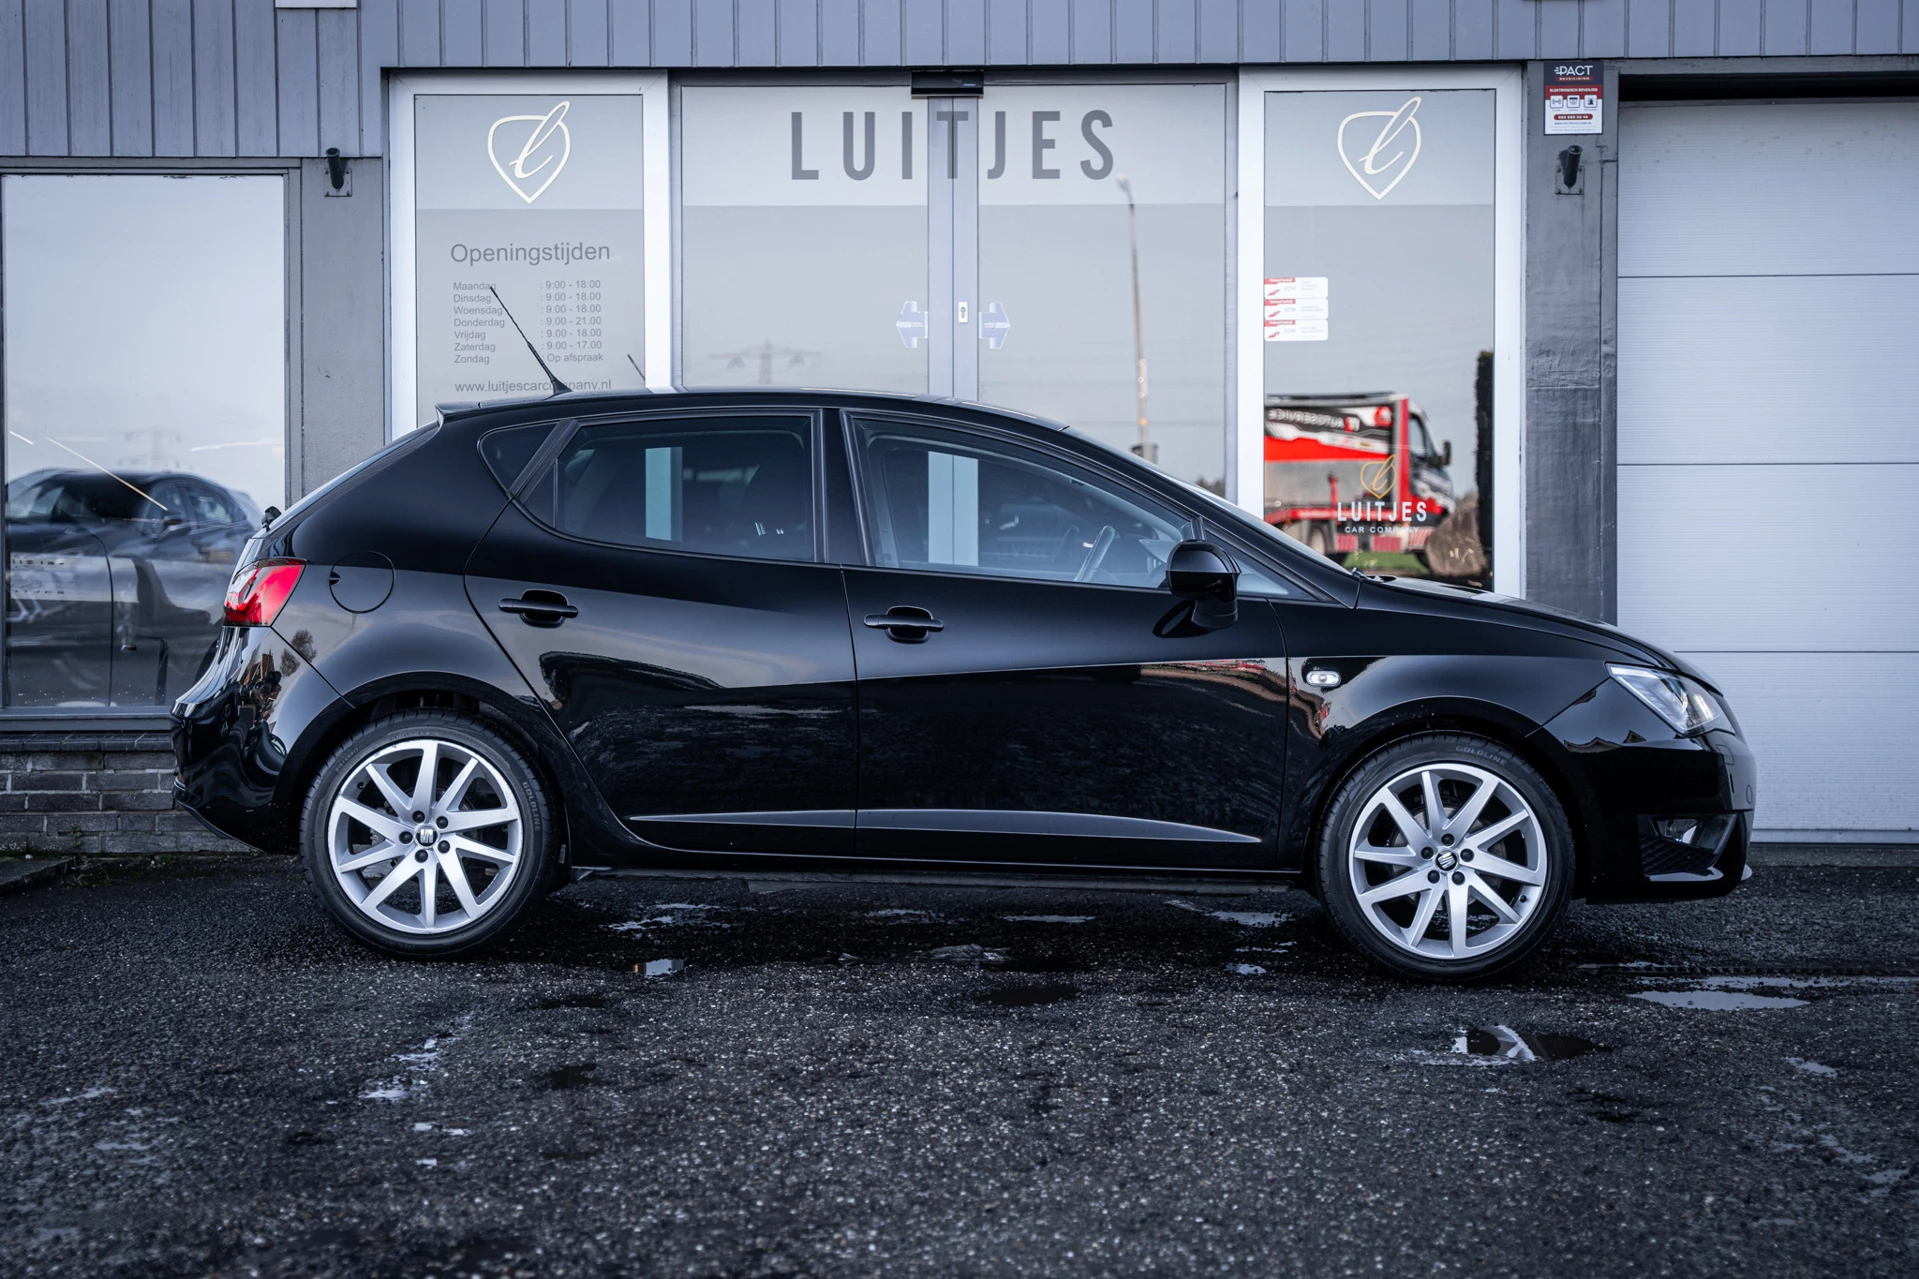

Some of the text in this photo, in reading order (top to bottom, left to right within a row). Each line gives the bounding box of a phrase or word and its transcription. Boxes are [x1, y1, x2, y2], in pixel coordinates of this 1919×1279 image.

[1555, 65, 1593, 76] PACT
[791, 109, 1114, 181] LUITJES
[450, 242, 610, 267] Openingstijden
[453, 293, 492, 304] Dinsdag
[545, 292, 566, 302] 9.00
[575, 291, 601, 301] 18.00
[453, 306, 503, 316] Woensdag
[546, 304, 567, 314] 9.00
[576, 303, 602, 313] 18.00
[453, 318, 505, 329] Donderdag
[546, 316, 567, 326] 9.00
[575, 316, 602, 325] 21.00
[453, 330, 486, 341] Vrijdag
[546, 328, 567, 338] 9.00
[576, 328, 602, 338] 18.00
[454, 342, 496, 353] Zaterdag
[546, 341, 567, 350] 9.00
[576, 340, 602, 350] 17.00
[454, 352, 604, 365] Zondag Op afspraak
[1337, 501, 1427, 522] LUITJES
[1455, 745, 1508, 766] GOLDLINE
[522, 781, 541, 832] GOLDLINE
